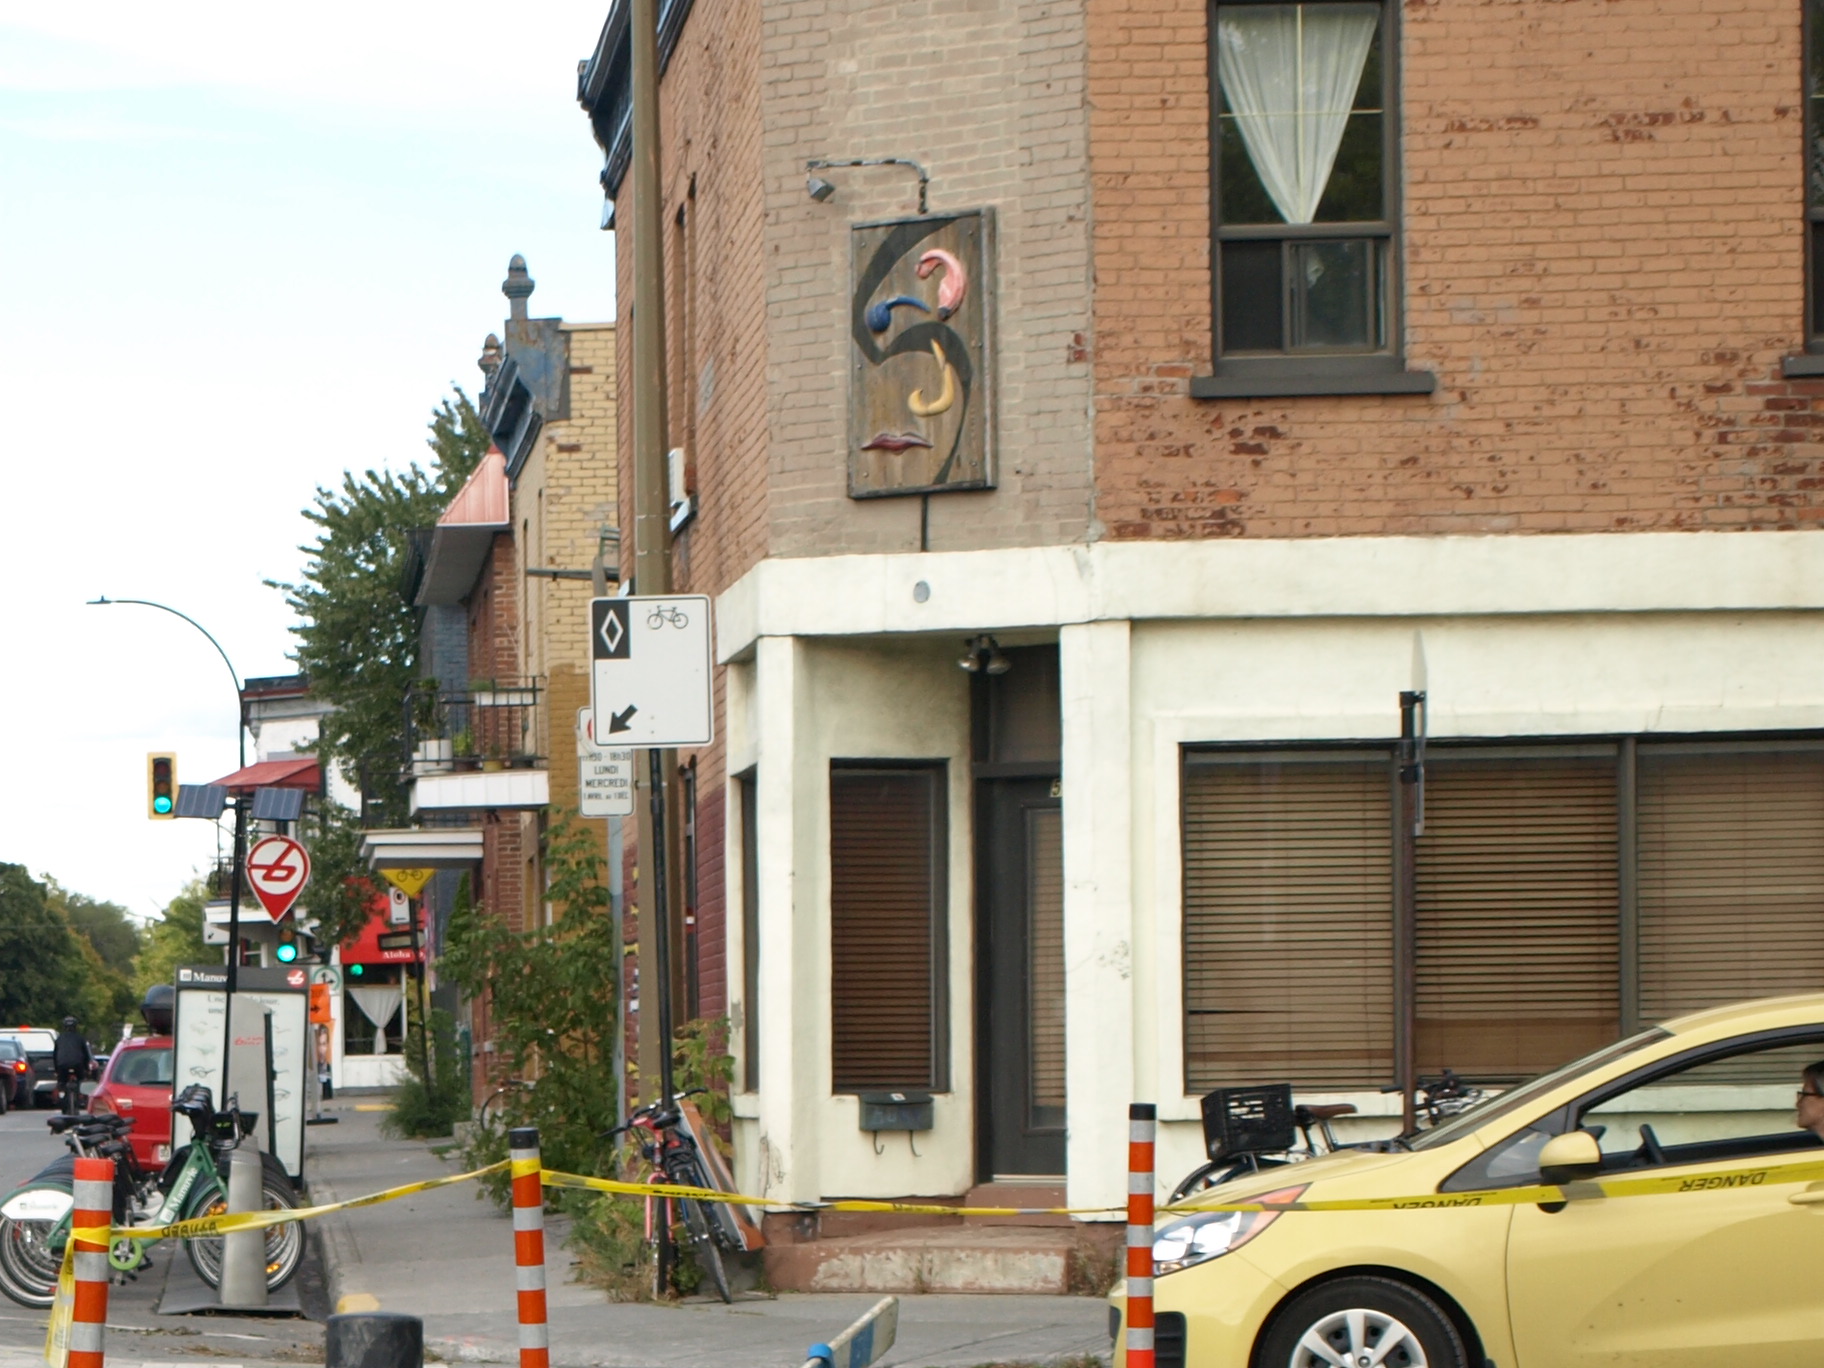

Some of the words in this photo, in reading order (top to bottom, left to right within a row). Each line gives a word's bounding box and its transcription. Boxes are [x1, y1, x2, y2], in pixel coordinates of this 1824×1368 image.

[594, 765, 619, 775] LUNDI
[585, 778, 629, 788] MERCREDI
[1678, 1171, 1767, 1193] DANGER
